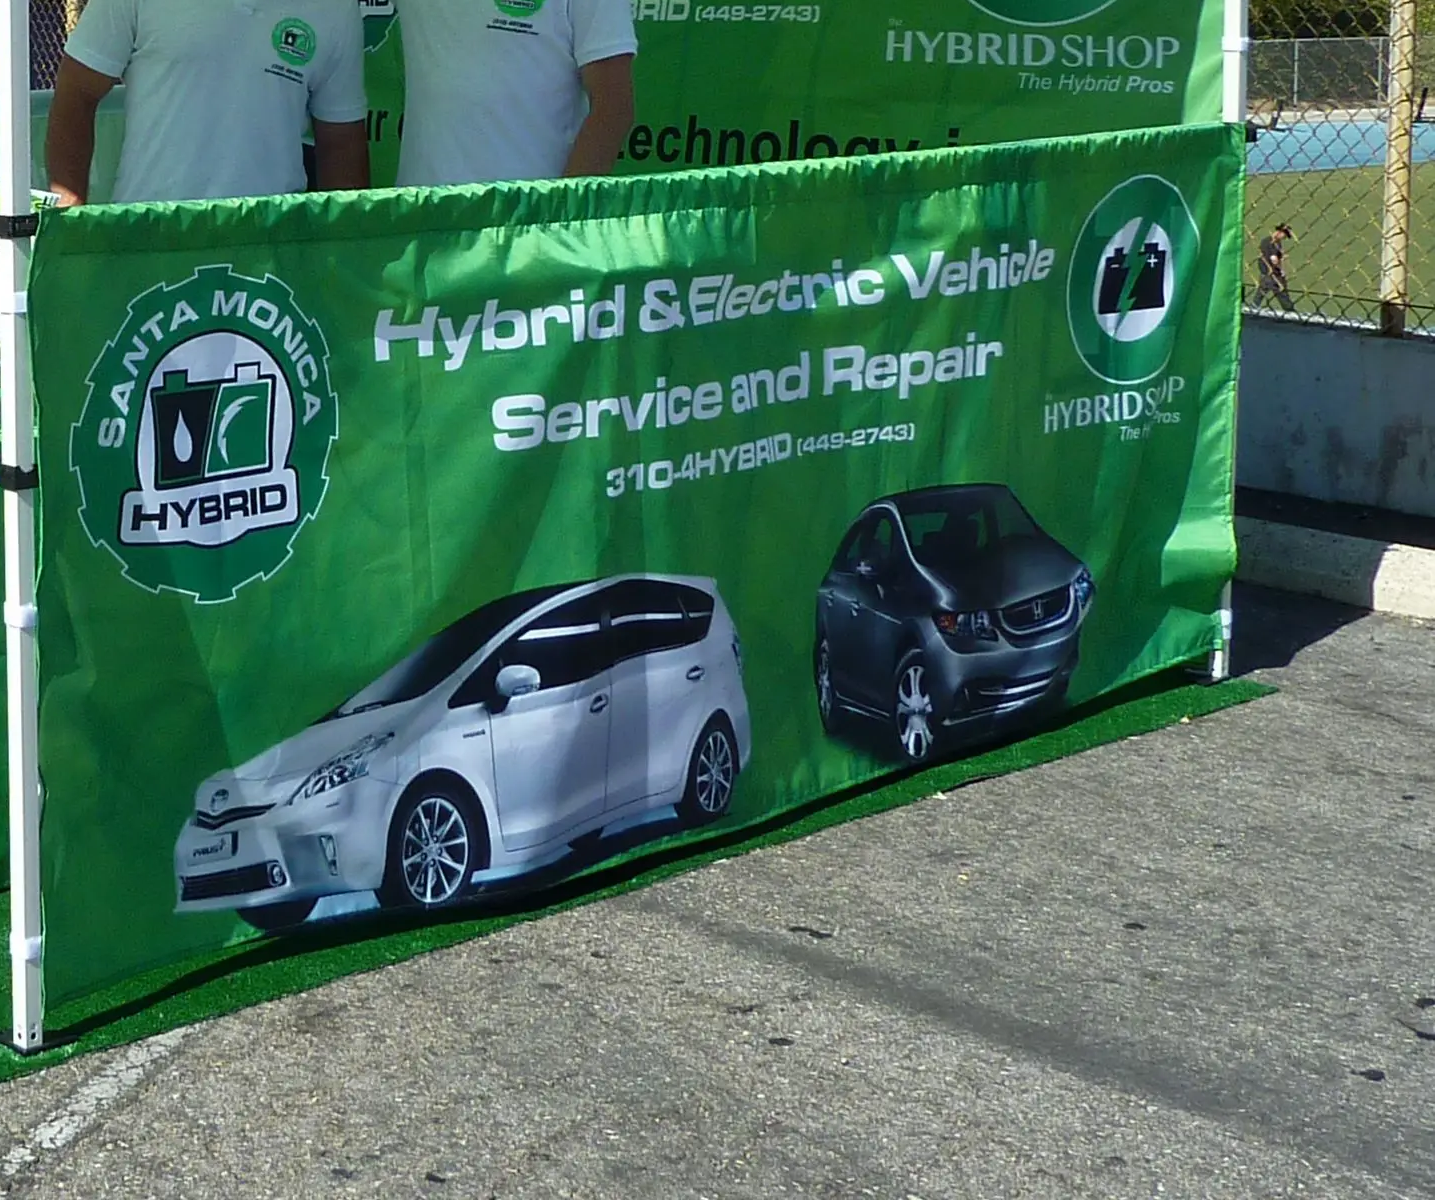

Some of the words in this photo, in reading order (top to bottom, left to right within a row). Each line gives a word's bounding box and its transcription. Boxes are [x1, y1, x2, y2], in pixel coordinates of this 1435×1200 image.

[695, 4, 820, 23] (449-2743)
[1018, 72, 1052, 90] The
[1058, 73, 1121, 95] Hybrid
[1125, 76, 1175, 94] Pros
[617, 115, 921, 164] echnolo
[373, 285, 626, 371] Hybrid
[638, 279, 686, 332] &
[688, 259, 886, 327] Electric
[890, 238, 1056, 300] Vehicle
[97, 300, 200, 448] SANTA
[211, 290, 322, 426] MONICA
[491, 376, 723, 452] Service
[730, 351, 811, 411] and
[822, 332, 1003, 400] Repair
[606, 433, 793, 498] 310-4HYBRID
[796, 422, 916, 457] (449-2743)
[130, 483, 287, 531] HYBRID
